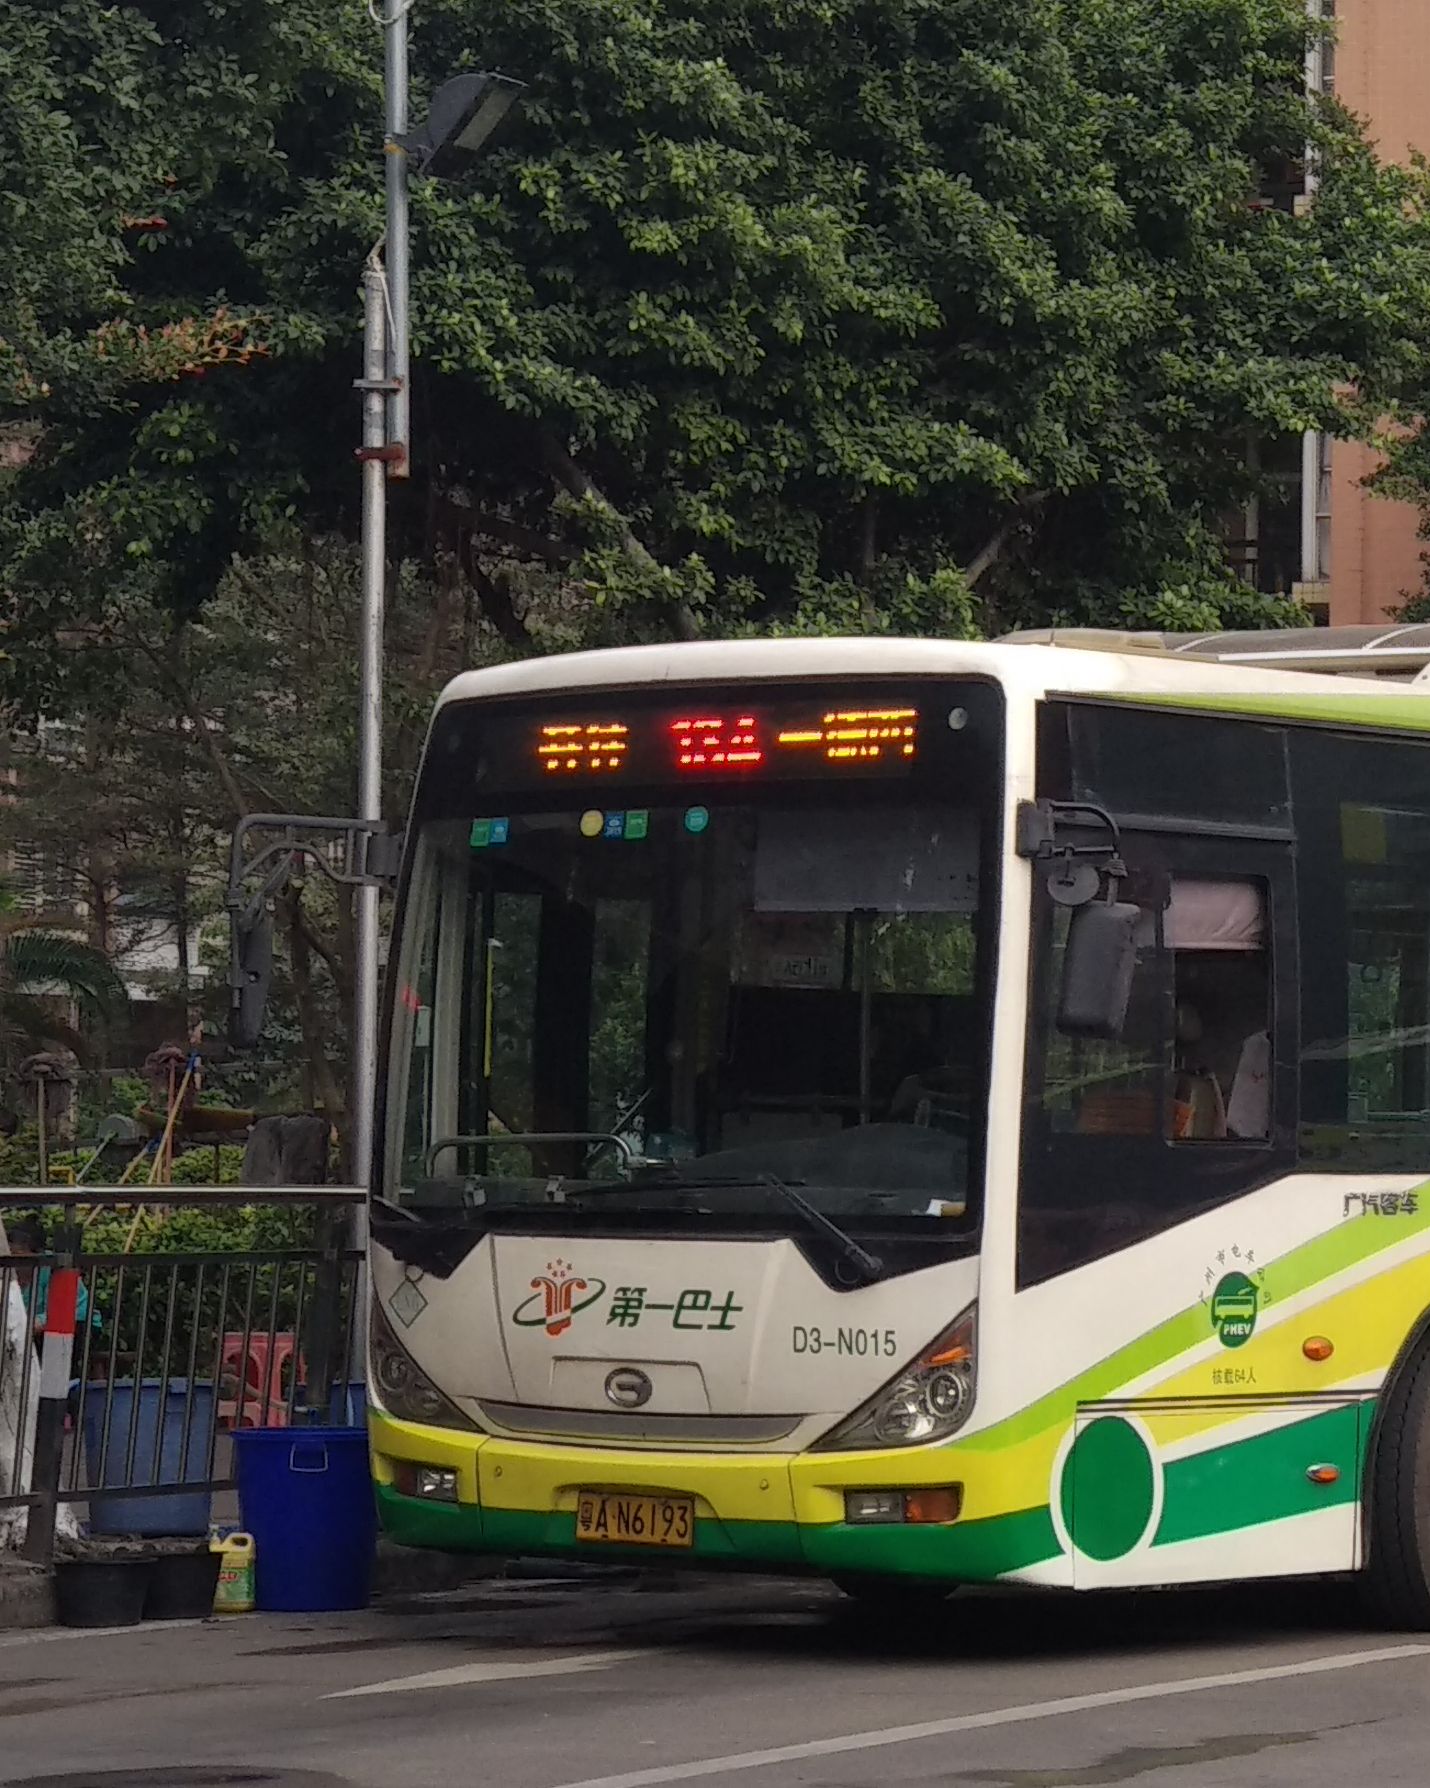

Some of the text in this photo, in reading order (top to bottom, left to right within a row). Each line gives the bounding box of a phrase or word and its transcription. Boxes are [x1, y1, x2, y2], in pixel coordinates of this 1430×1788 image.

[605, 1286, 743, 1330] 第一巴士
[793, 1325, 897, 1356] D3-N015
[1223, 1322, 1252, 1336] PHEV
